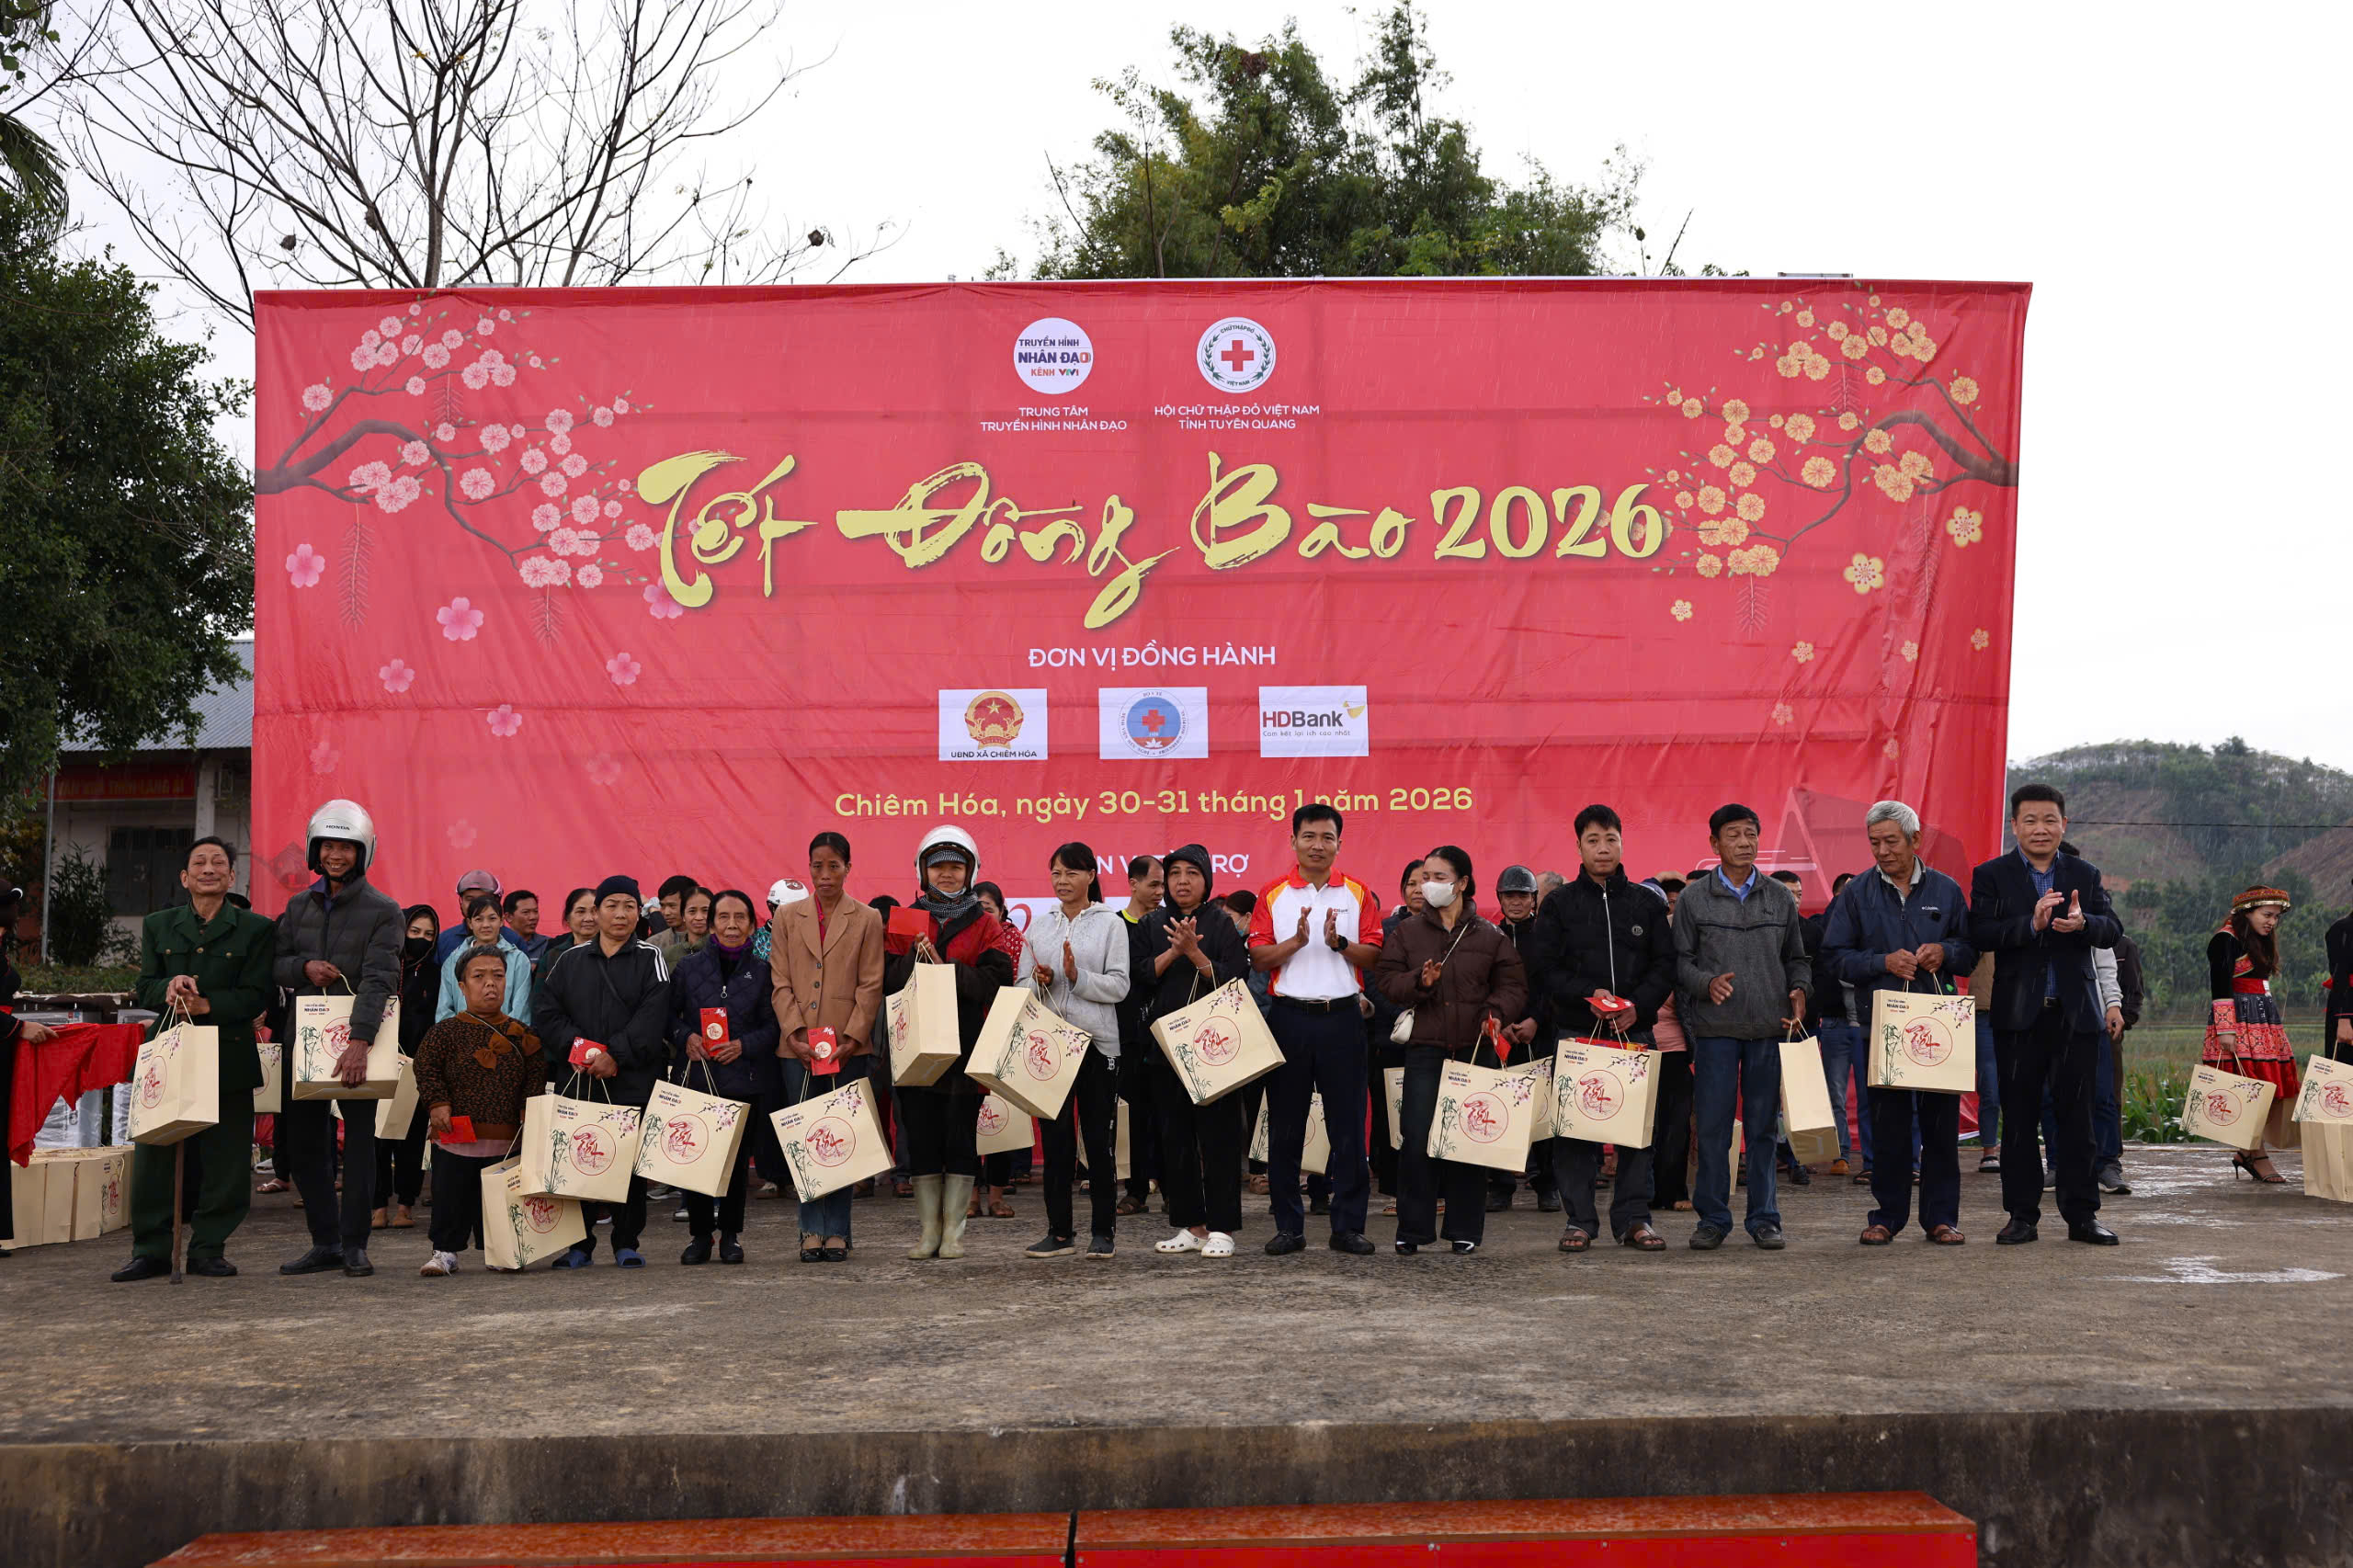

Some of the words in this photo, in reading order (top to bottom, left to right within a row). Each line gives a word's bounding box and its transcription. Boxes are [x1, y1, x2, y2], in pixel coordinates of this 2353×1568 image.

[1018, 349, 1057, 363] NHÂN
[1059, 352, 1091, 366] ĐẠO
[1031, 367, 1055, 376] KÊNH
[1018, 407, 1060, 417] TRUNG
[1063, 405, 1088, 416] TÂM
[1154, 404, 1176, 418] HỘI
[1178, 404, 1205, 415] CHỮ
[1207, 404, 1240, 418] THẬP
[1242, 403, 1260, 415] ĐỎ
[1263, 403, 1290, 417] VIỆT
[1292, 405, 1320, 415] NAM
[980, 419, 1029, 431] TRUYỀN
[1032, 419, 1060, 431] HÌNH
[1063, 419, 1097, 431] NHÂN
[1100, 420, 1127, 433] ĐẠO
[1178, 416, 1207, 430] TỈNH
[1209, 418, 1249, 430] TUYÊN
[1252, 419, 1296, 430] QUANG
[637, 450, 818, 608] Tết
[1190, 451, 1416, 569] Bào
[1430, 484, 1663, 560] 2026
[1028, 648, 1086, 667] ĐƠN
[1091, 648, 1116, 671] VỊ
[1121, 639, 1196, 667] ĐỒNG
[1203, 642, 1276, 666] HÀNH
[1263, 710, 1343, 728] HDBank
[835, 793, 928, 817] Chiêm
[938, 792, 1007, 818] Hóa,
[1016, 792, 1090, 824] ngày
[1098, 790, 1189, 814] 30-31
[1198, 790, 1286, 821] tháng
[1294, 789, 1303, 809] 1
[1315, 790, 1379, 811] năm
[1390, 787, 1472, 811] 2026
[1212, 853, 1250, 878] RỢ
